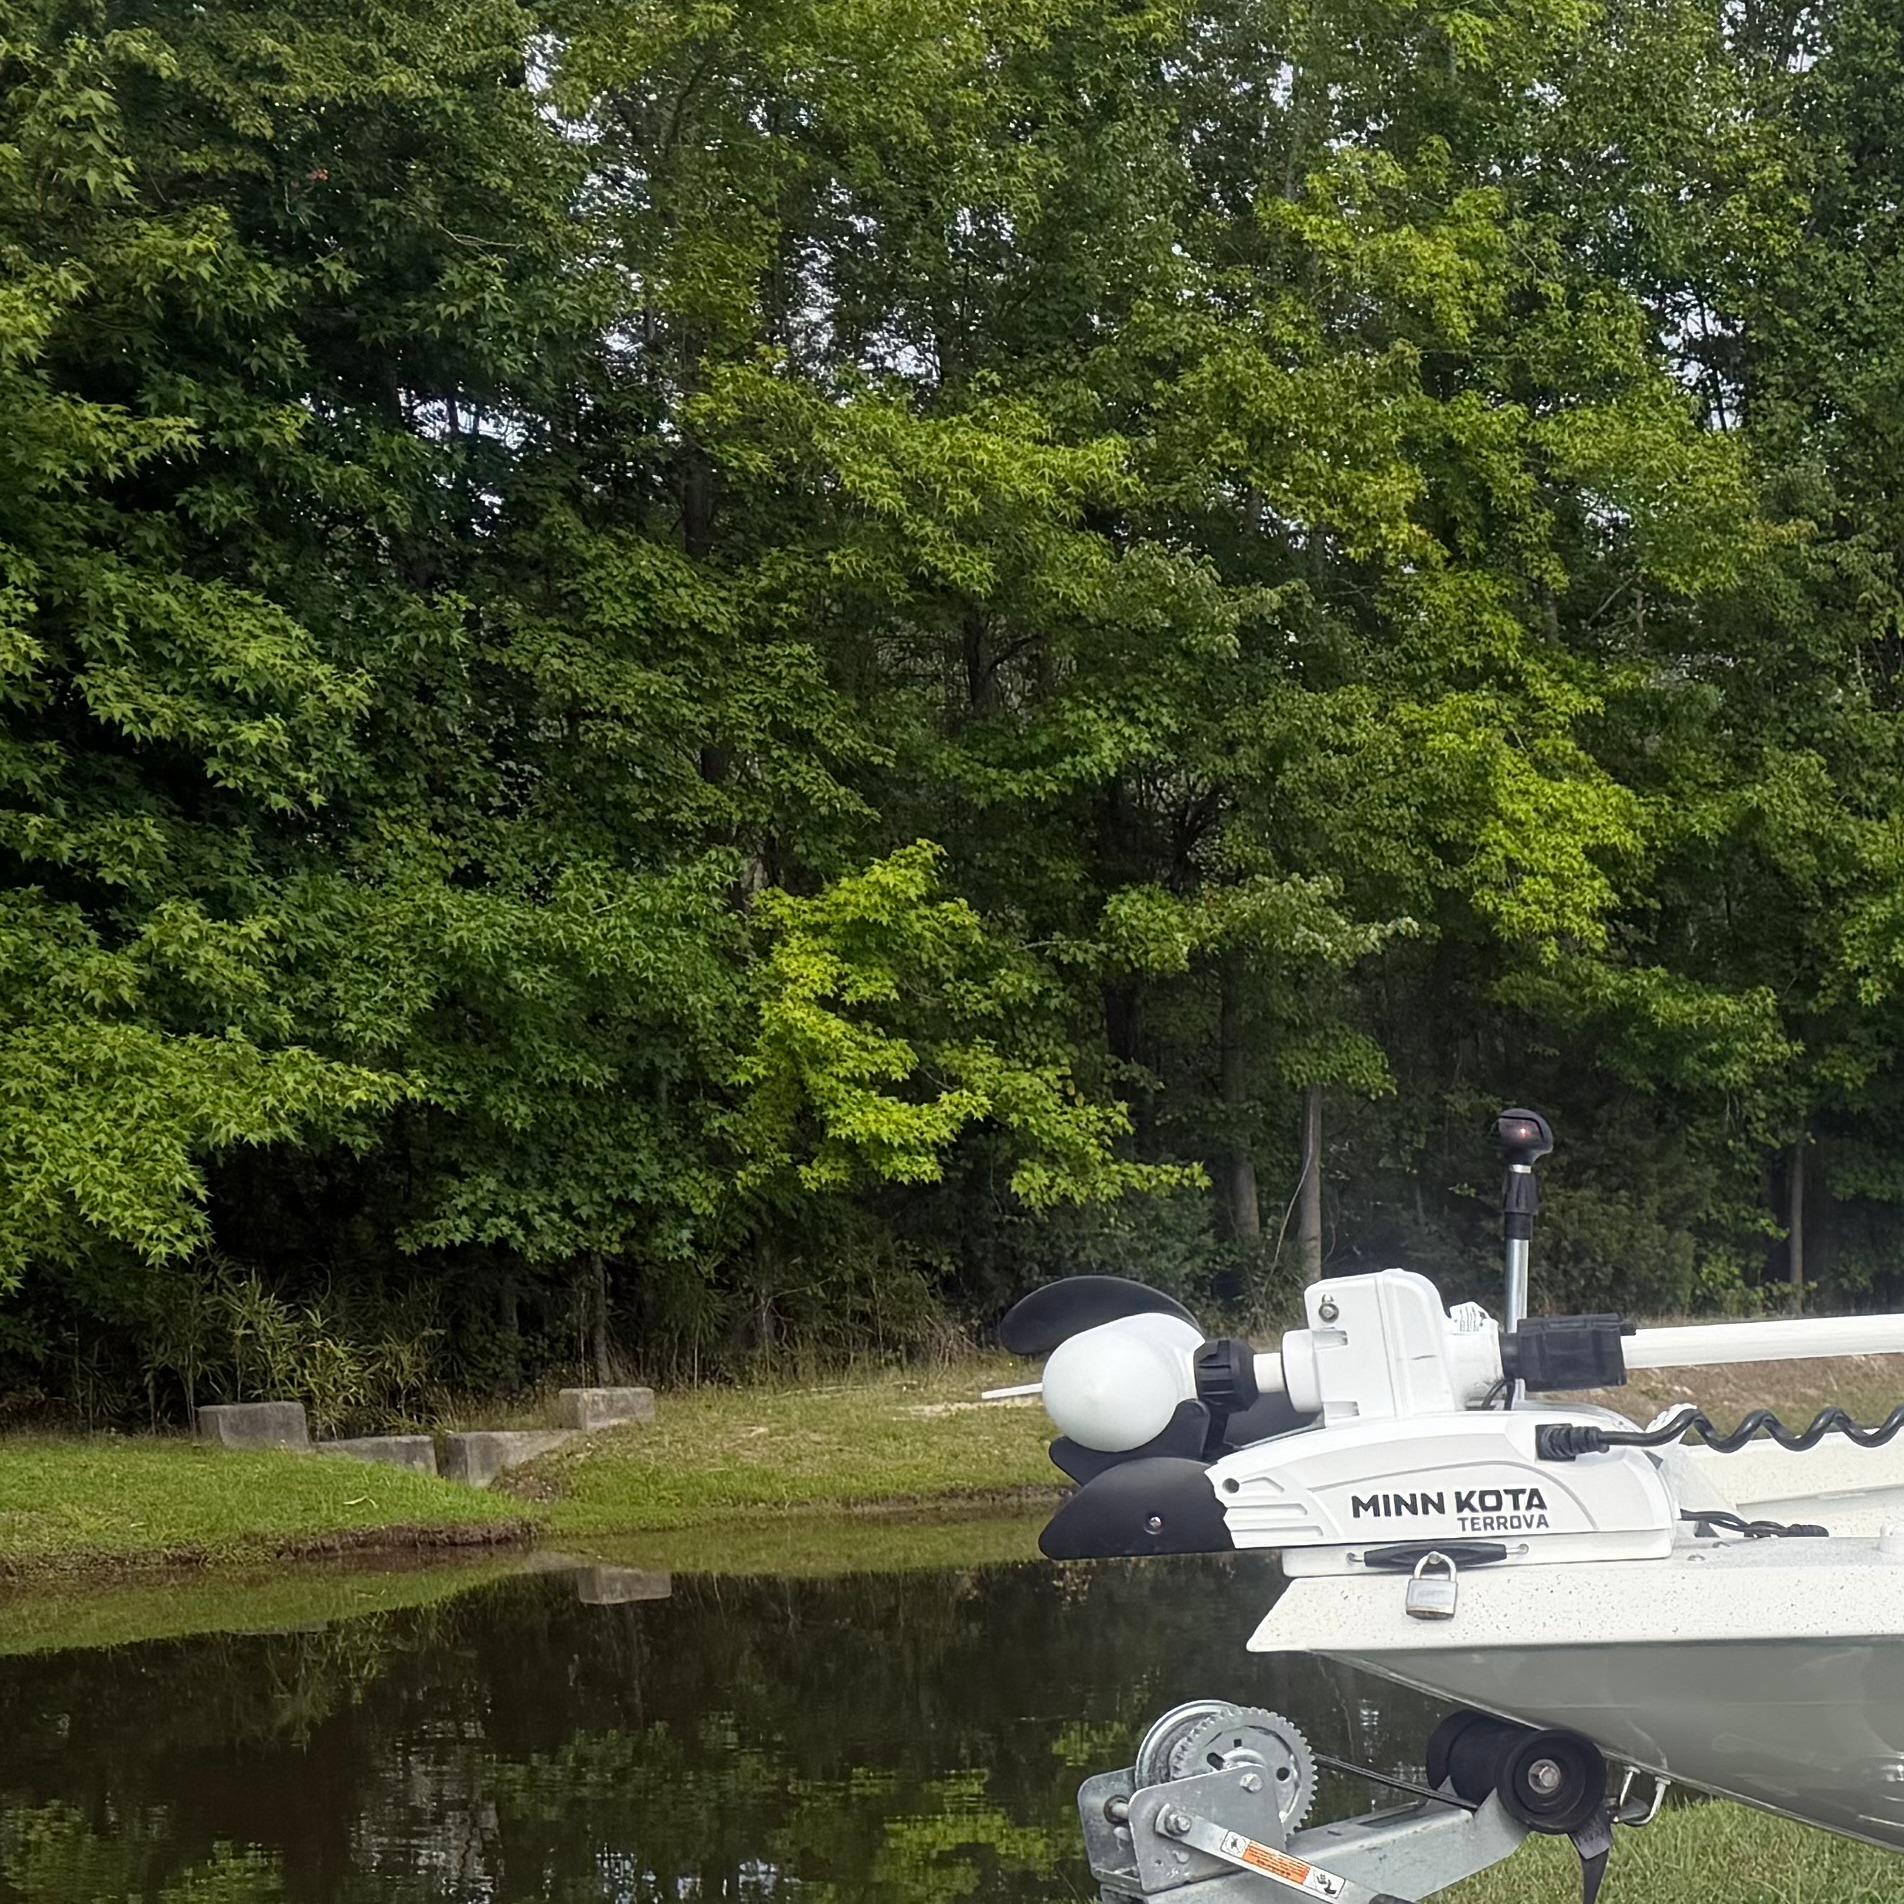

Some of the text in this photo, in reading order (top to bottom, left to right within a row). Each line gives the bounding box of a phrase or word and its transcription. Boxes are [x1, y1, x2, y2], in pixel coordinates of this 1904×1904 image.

[1351, 1487, 1548, 1518] MINN KOTA
[1456, 1513, 1550, 1532] TERROVA
